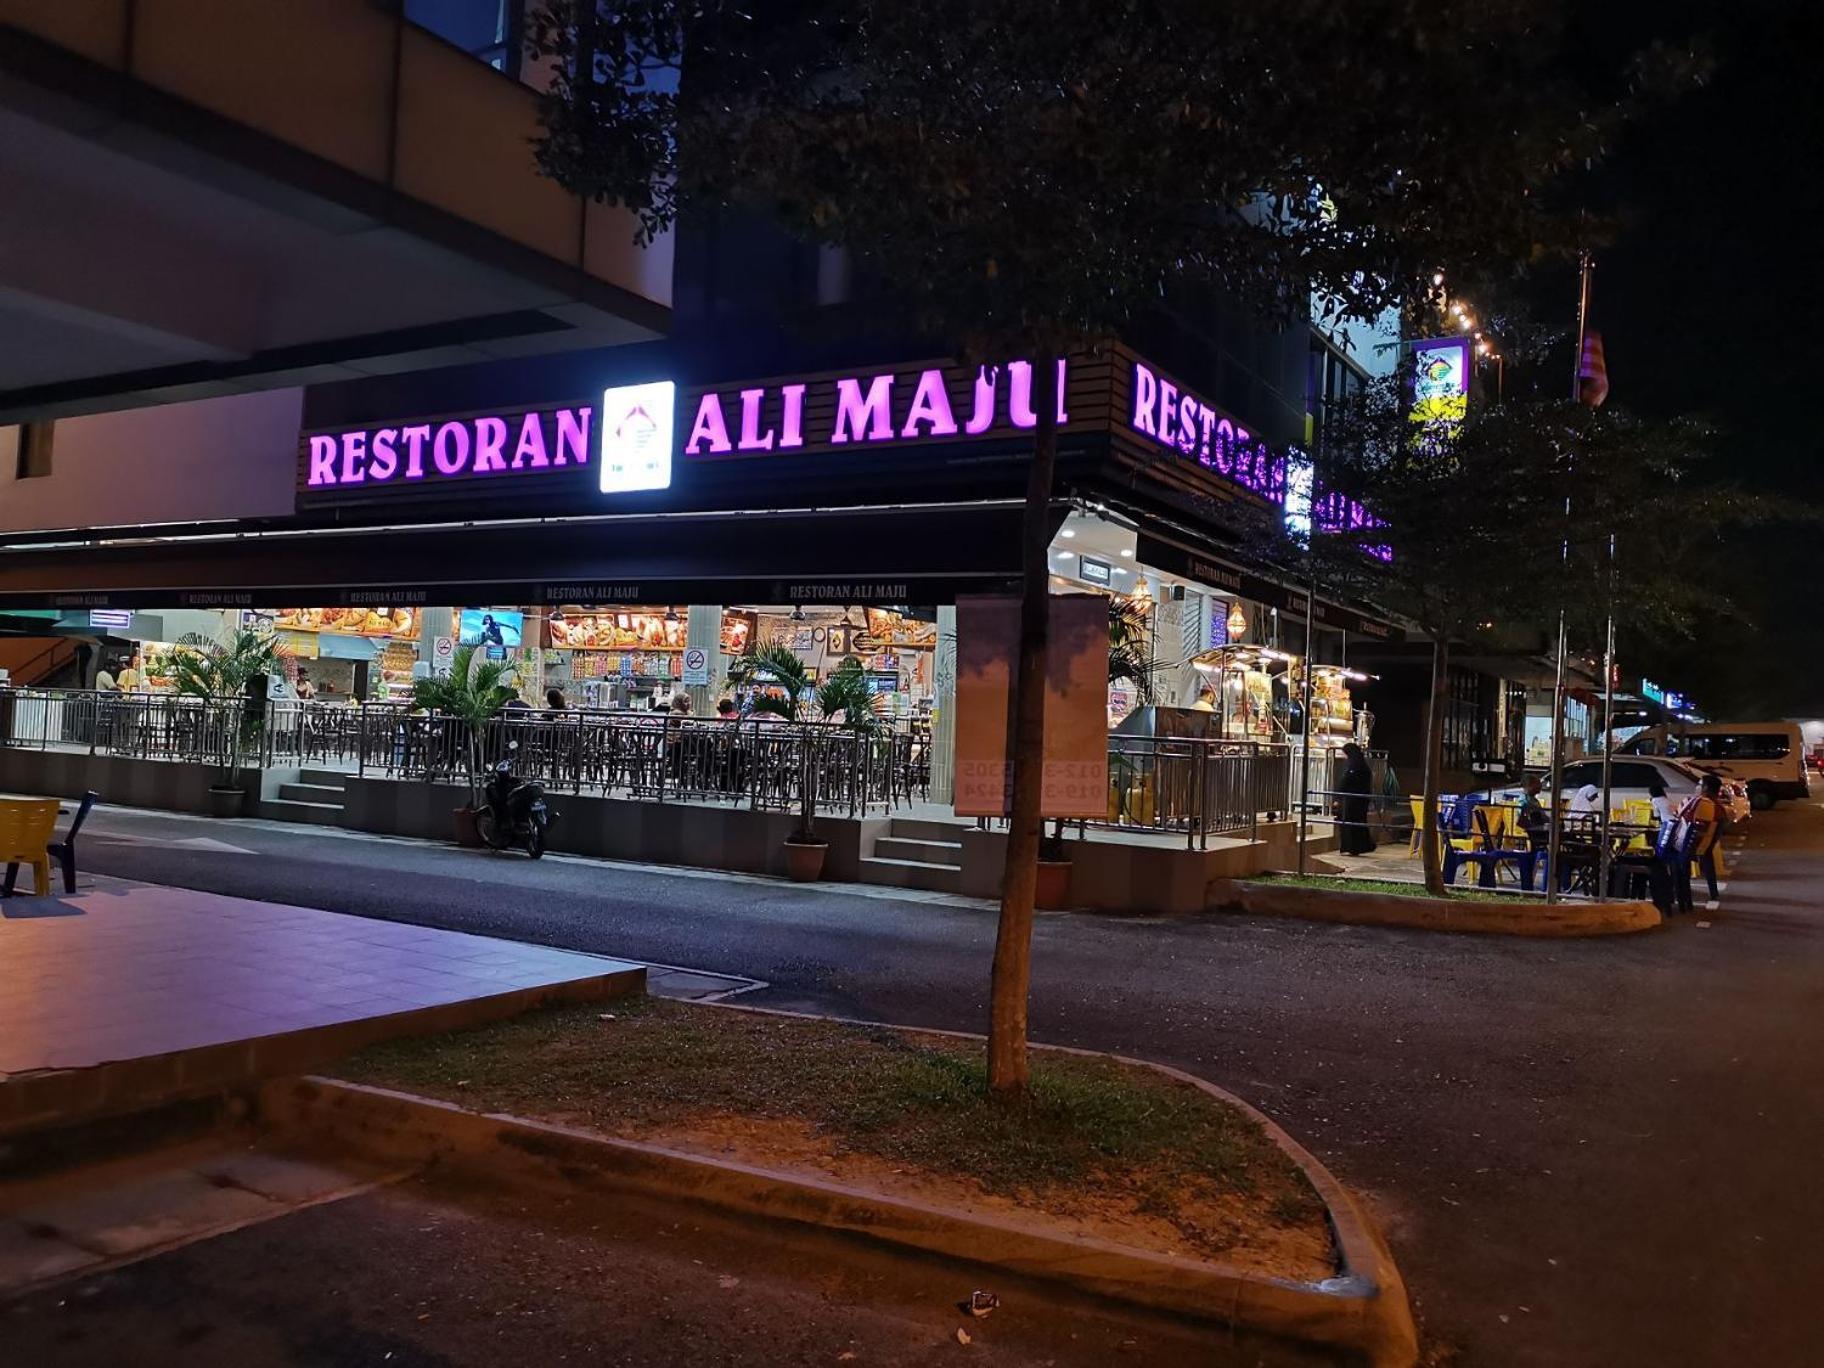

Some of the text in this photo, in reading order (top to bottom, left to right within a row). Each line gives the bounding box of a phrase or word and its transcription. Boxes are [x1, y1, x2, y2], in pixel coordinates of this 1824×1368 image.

[307, 358, 1068, 485] RESTORAN ALI MAJU
[547, 586, 639, 600] RESTORAN ALI MAJU
[790, 584, 907, 598] RESTORAN ALI MAJU
